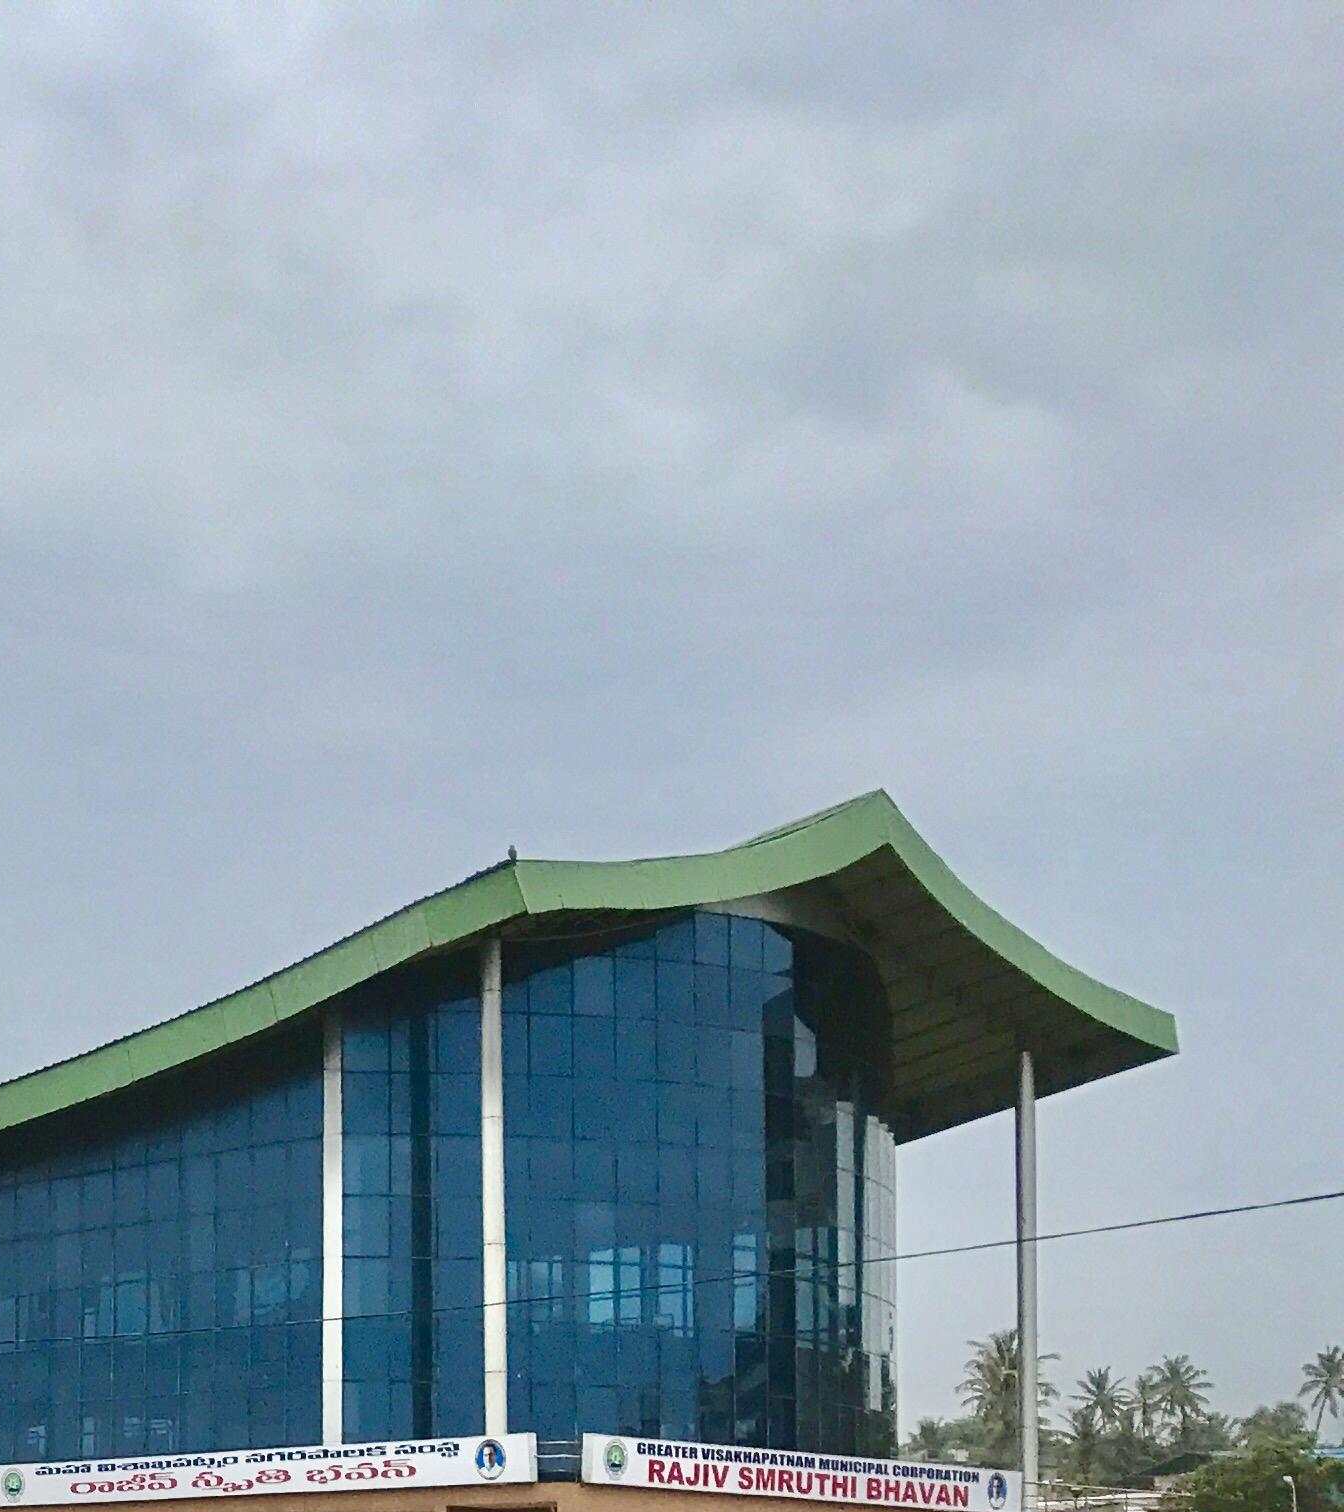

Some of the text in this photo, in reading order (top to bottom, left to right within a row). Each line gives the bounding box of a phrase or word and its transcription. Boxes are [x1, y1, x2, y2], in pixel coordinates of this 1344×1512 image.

[70, 1470, 178, 1495] రాజీవ్
[305, 1458, 417, 1485] భవన్
[636, 1442, 981, 1483] GREATER VISAKHAPATNAM MUNICIPAL CORPORATION
[647, 1459, 969, 1508] RAJIV SMRUTHI BHAVAN
